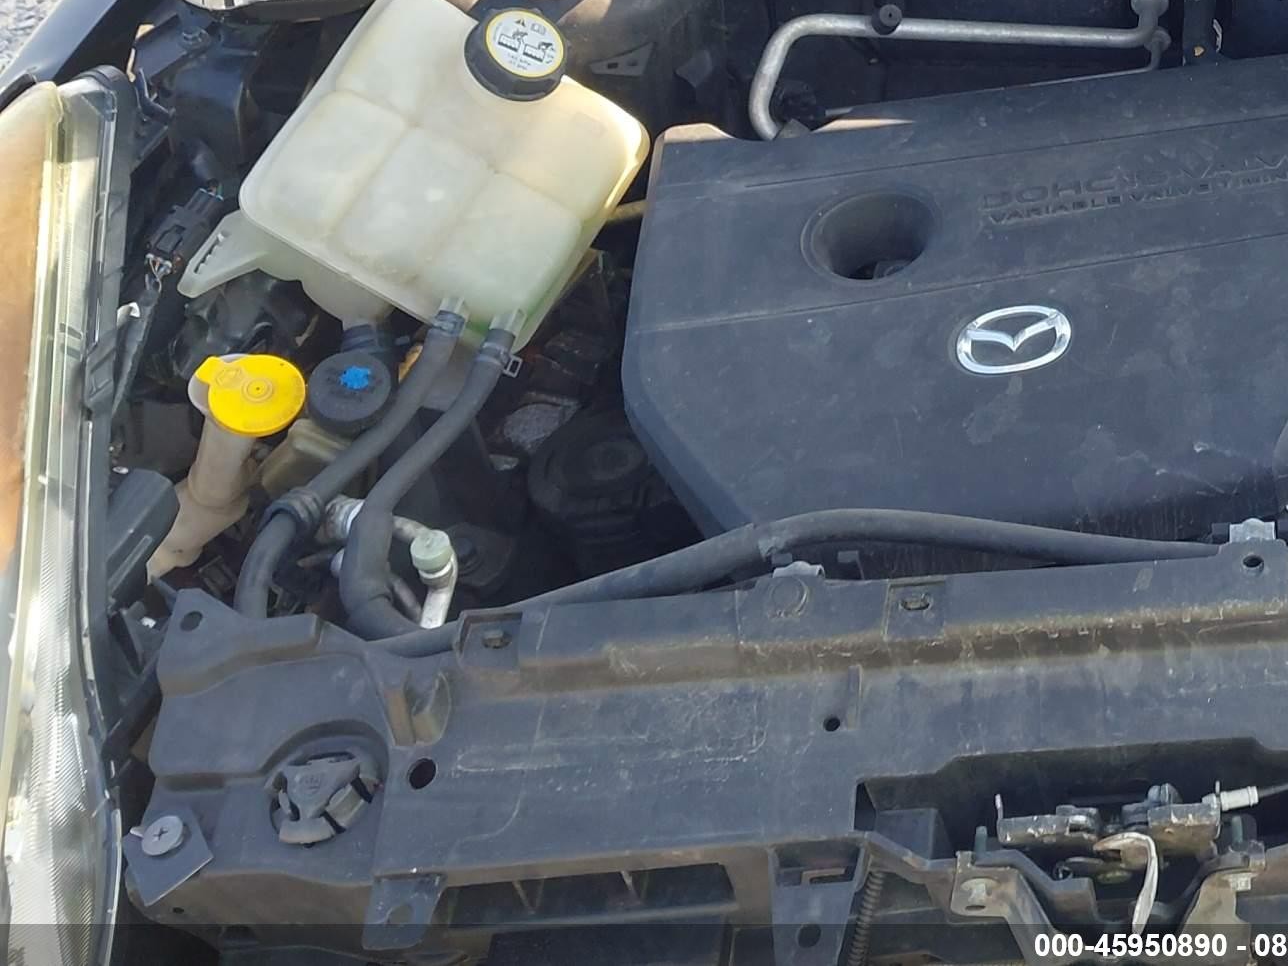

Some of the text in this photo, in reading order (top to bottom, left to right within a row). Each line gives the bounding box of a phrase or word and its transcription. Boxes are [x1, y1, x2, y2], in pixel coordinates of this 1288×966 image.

[979, 177, 1116, 211] DOHC
[989, 195, 1123, 224] VARIABLE
[1128, 180, 1214, 203] VALVE
